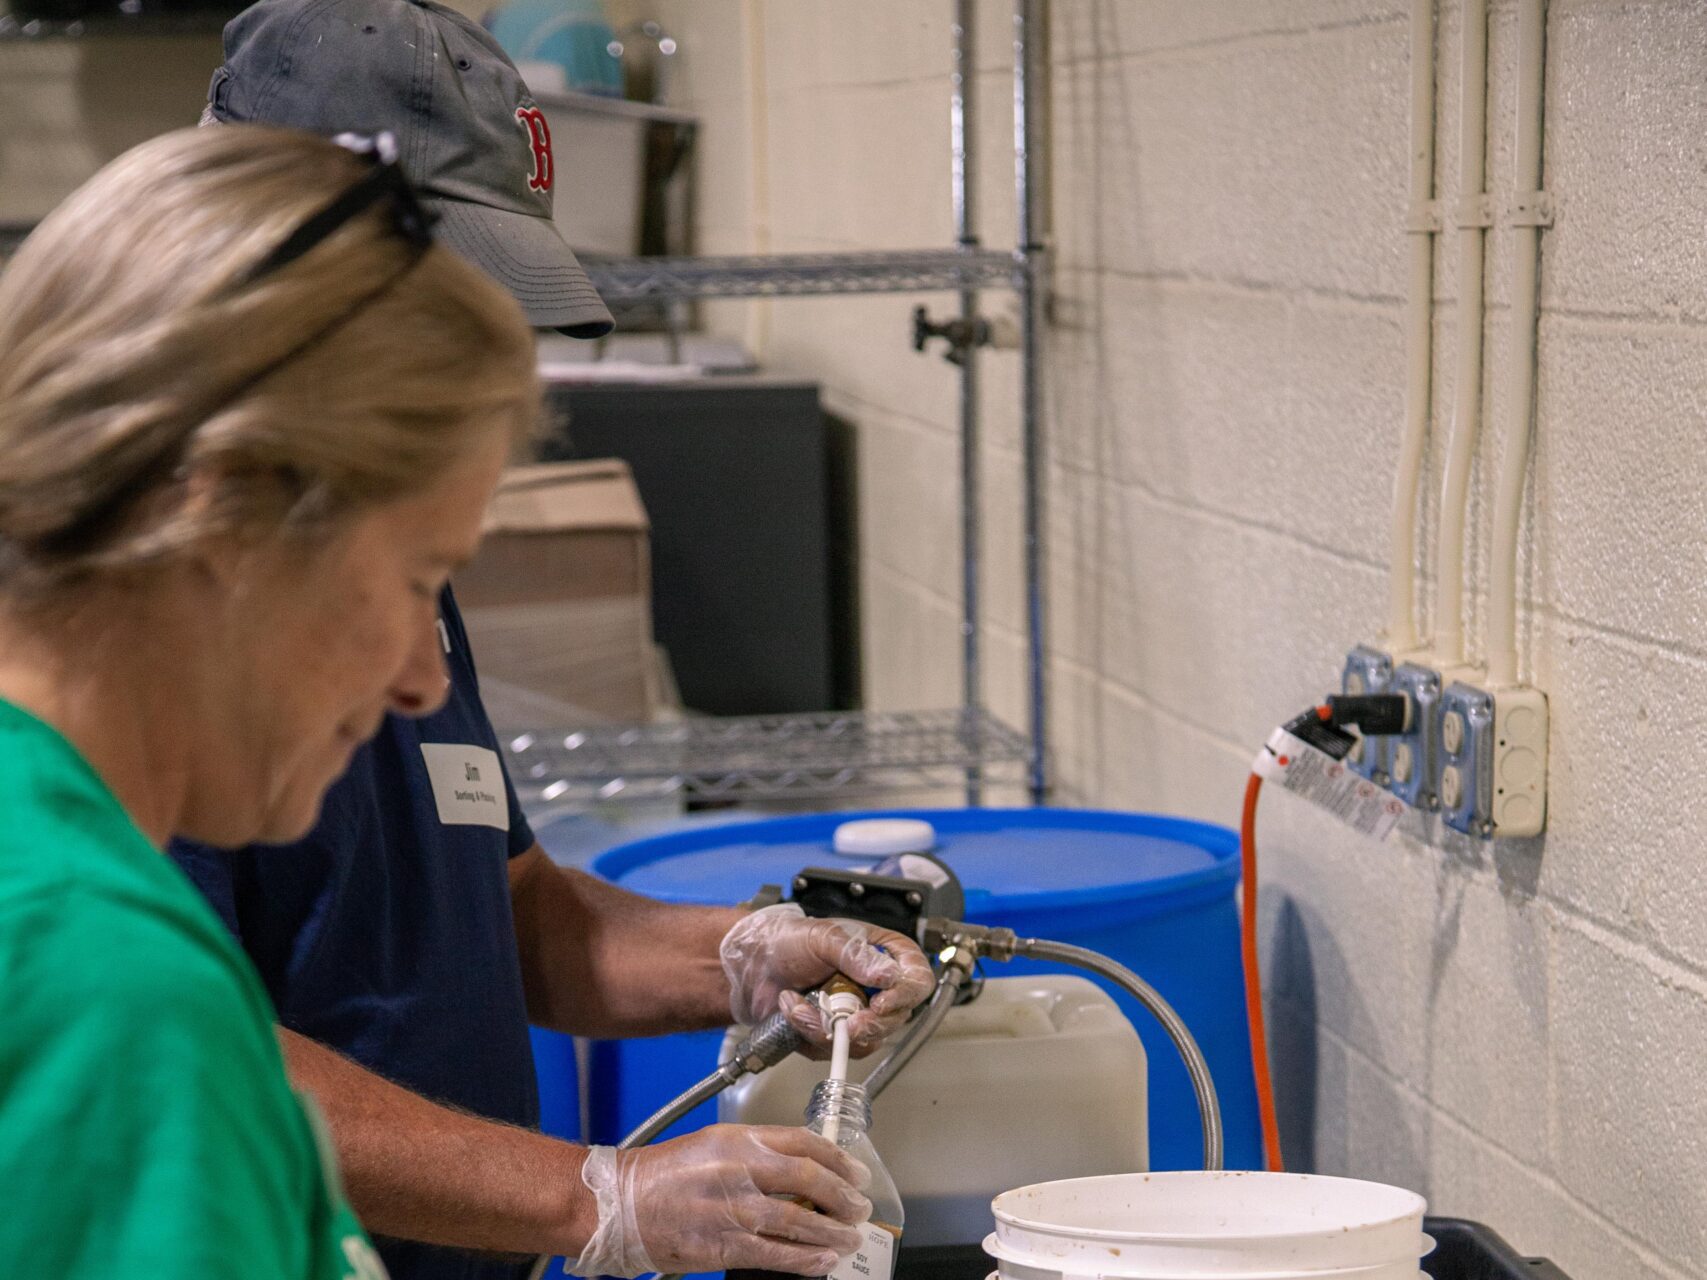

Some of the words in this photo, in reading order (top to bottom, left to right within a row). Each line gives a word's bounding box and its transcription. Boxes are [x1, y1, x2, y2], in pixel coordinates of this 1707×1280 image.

[514, 107, 553, 193] B
[464, 762, 481, 781] Jim
[856, 1252, 868, 1263] SOY
[851, 1261, 870, 1276] SAUCE
